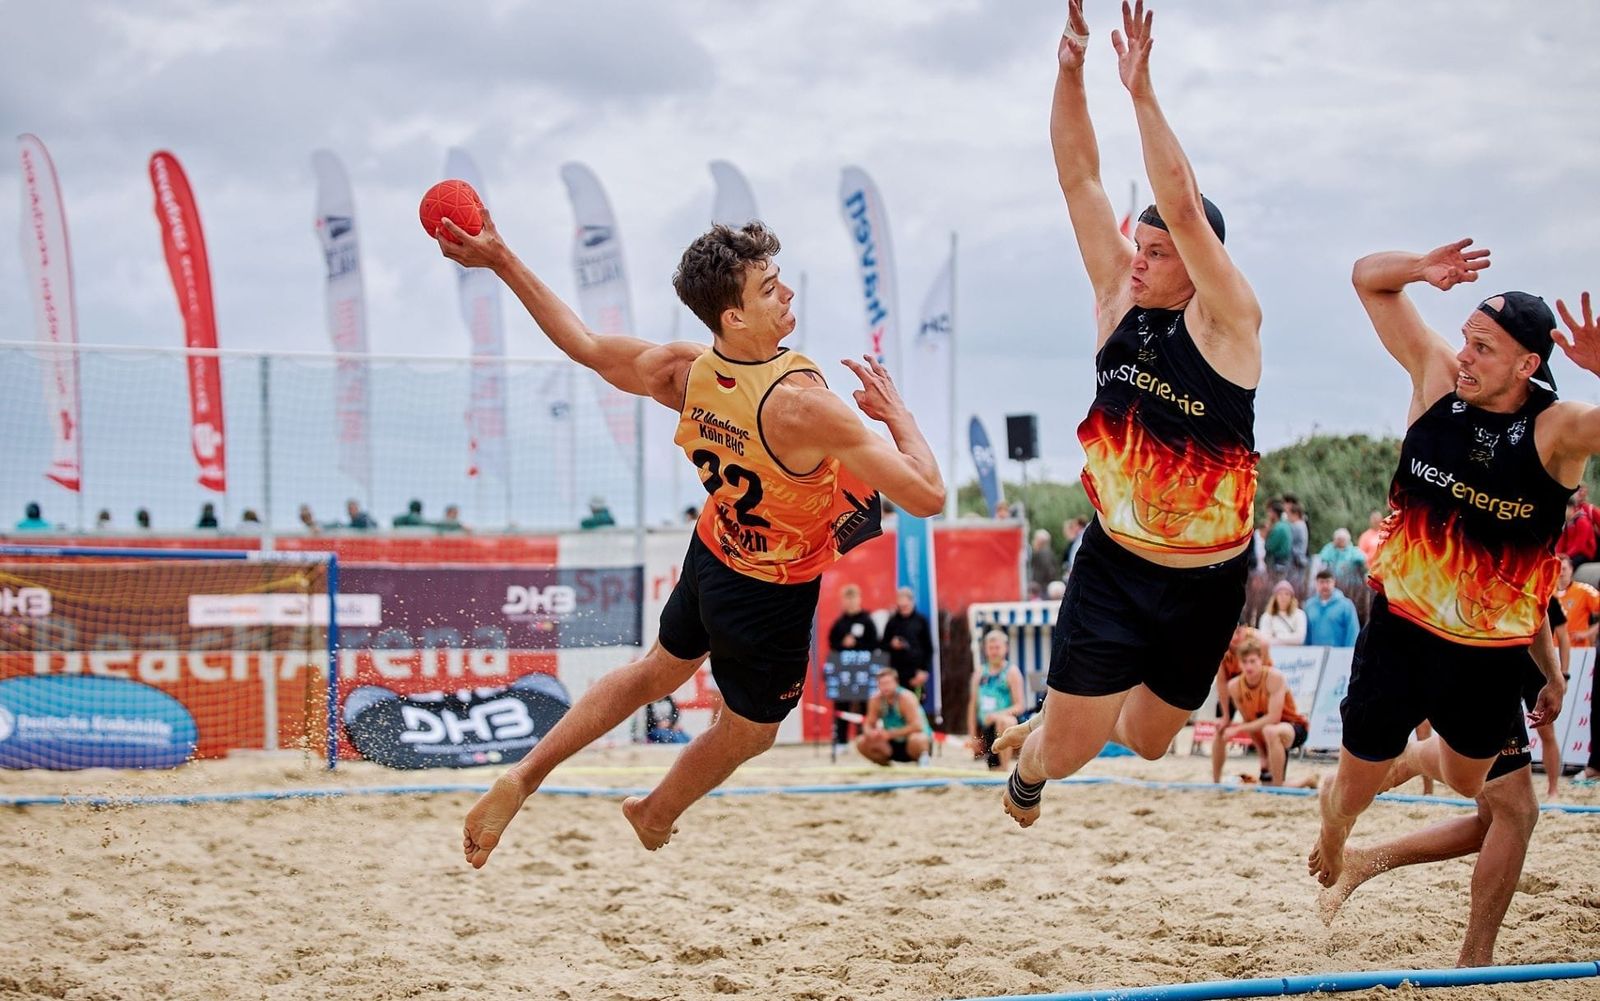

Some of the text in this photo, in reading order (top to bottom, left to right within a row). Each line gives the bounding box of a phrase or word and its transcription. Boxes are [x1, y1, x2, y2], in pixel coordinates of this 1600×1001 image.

[691, 407, 704, 421] 12
[699, 424, 745, 457] Köln BHC
[692, 449, 771, 529] 22
[1410, 457, 1534, 520] westenergie
[0, 587, 52, 618] HB
[502, 585, 577, 615] DHB
[32, 619, 509, 682] Beach Arena
[401, 697, 535, 745] DHB
